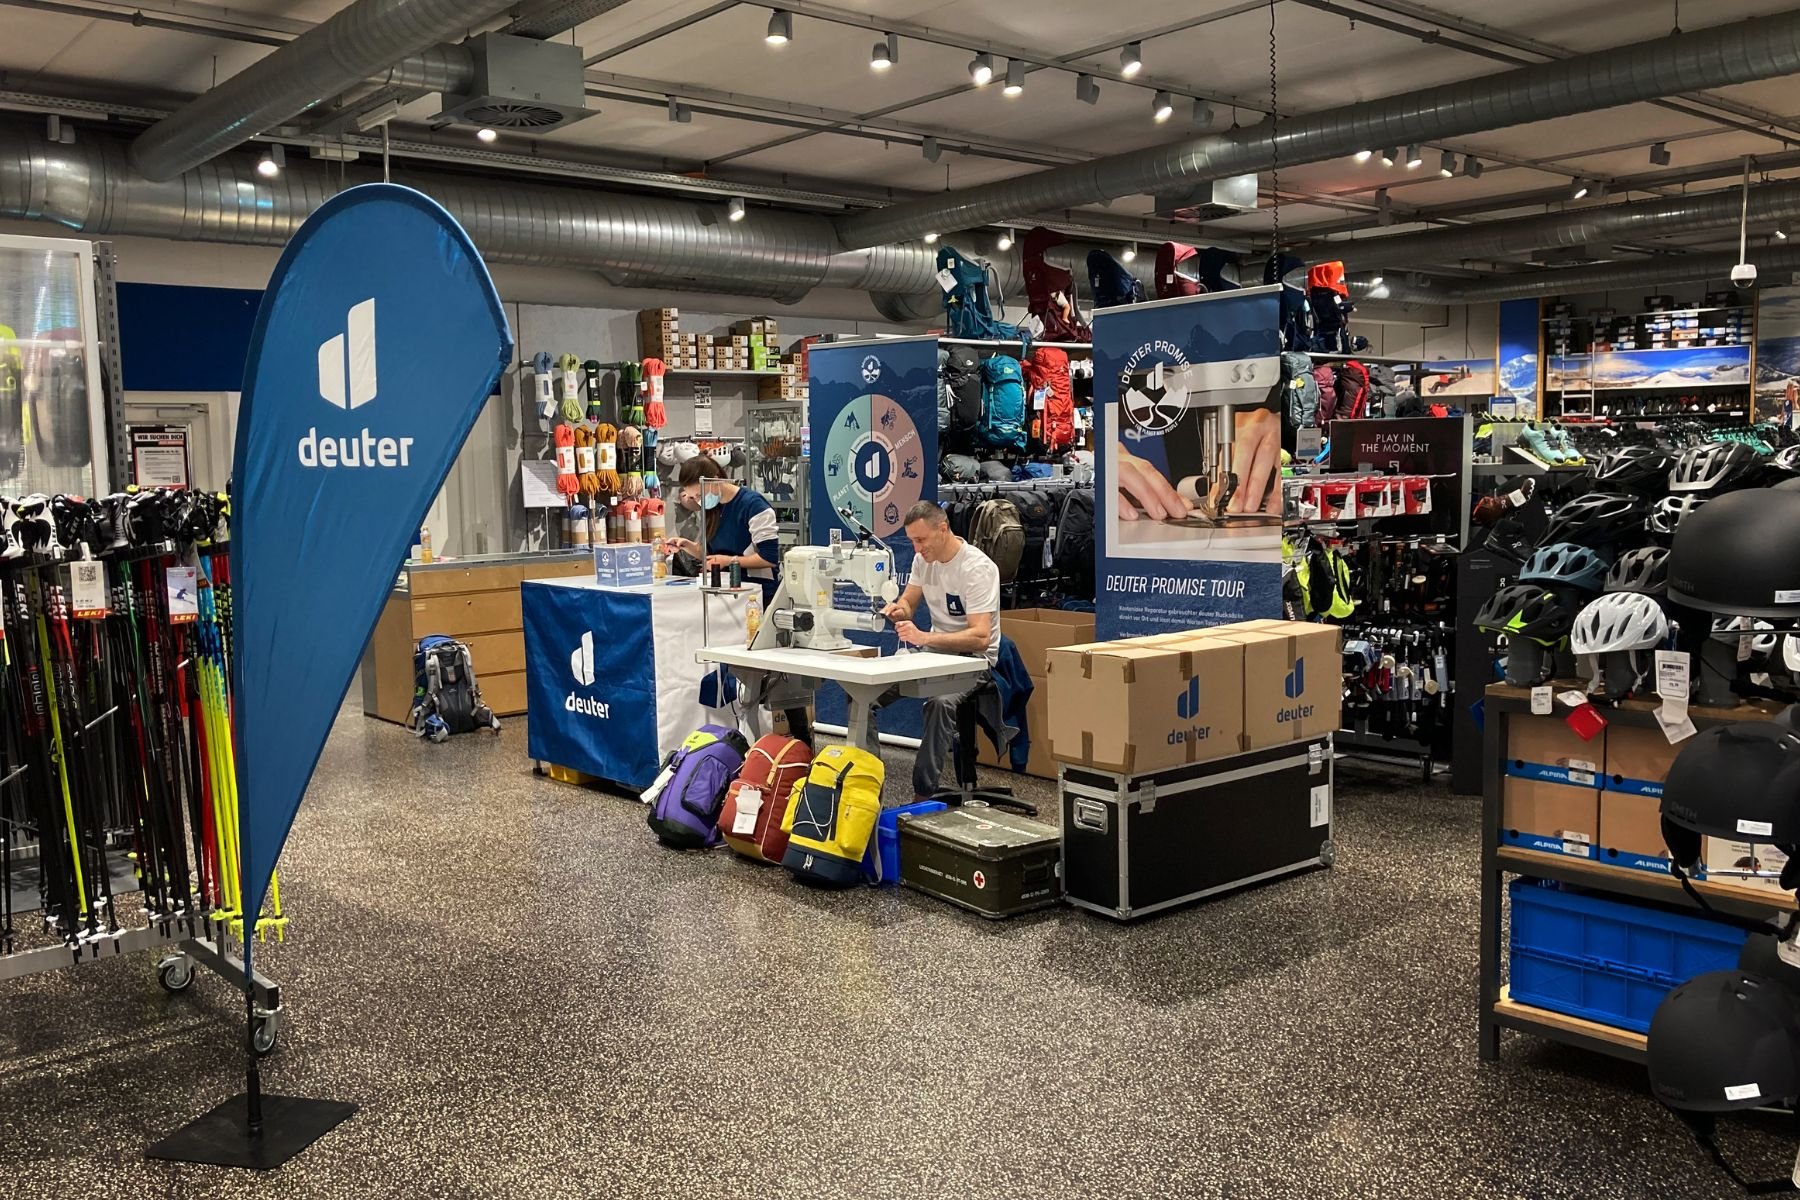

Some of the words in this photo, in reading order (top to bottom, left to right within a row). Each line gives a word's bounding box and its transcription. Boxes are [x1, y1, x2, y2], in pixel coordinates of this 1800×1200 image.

[1121, 342, 1152, 384] DEUTER
[1154, 340, 1193, 380] PROMISE
[298, 427, 414, 467] deuter
[894, 430, 916, 450] MENSCH
[1376, 433, 1399, 443] PLAY
[1403, 433, 1415, 443] IN
[1361, 443, 1379, 453] THE
[1383, 443, 1430, 453] MOMENT
[833, 484, 850, 502] PLANET
[1106, 574, 1148, 593] DEUTER
[1151, 577, 1207, 596] PROMISE
[1210, 579, 1245, 598] TOUR
[16, 583, 30, 620] LEKI
[55, 585, 69, 620] LEKI
[1286, 600, 1296, 621] uvex
[77, 609, 103, 617] LEKI
[173, 613, 197, 621] LEKI
[565, 691, 610, 719] deuter
[1277, 704, 1315, 723] deuter
[1167, 725, 1212, 745] deuter
[1538, 770, 1568, 780] ALPINA
[1533, 840, 1563, 850] ALPINA
[1634, 859, 1669, 871] ALPINA
